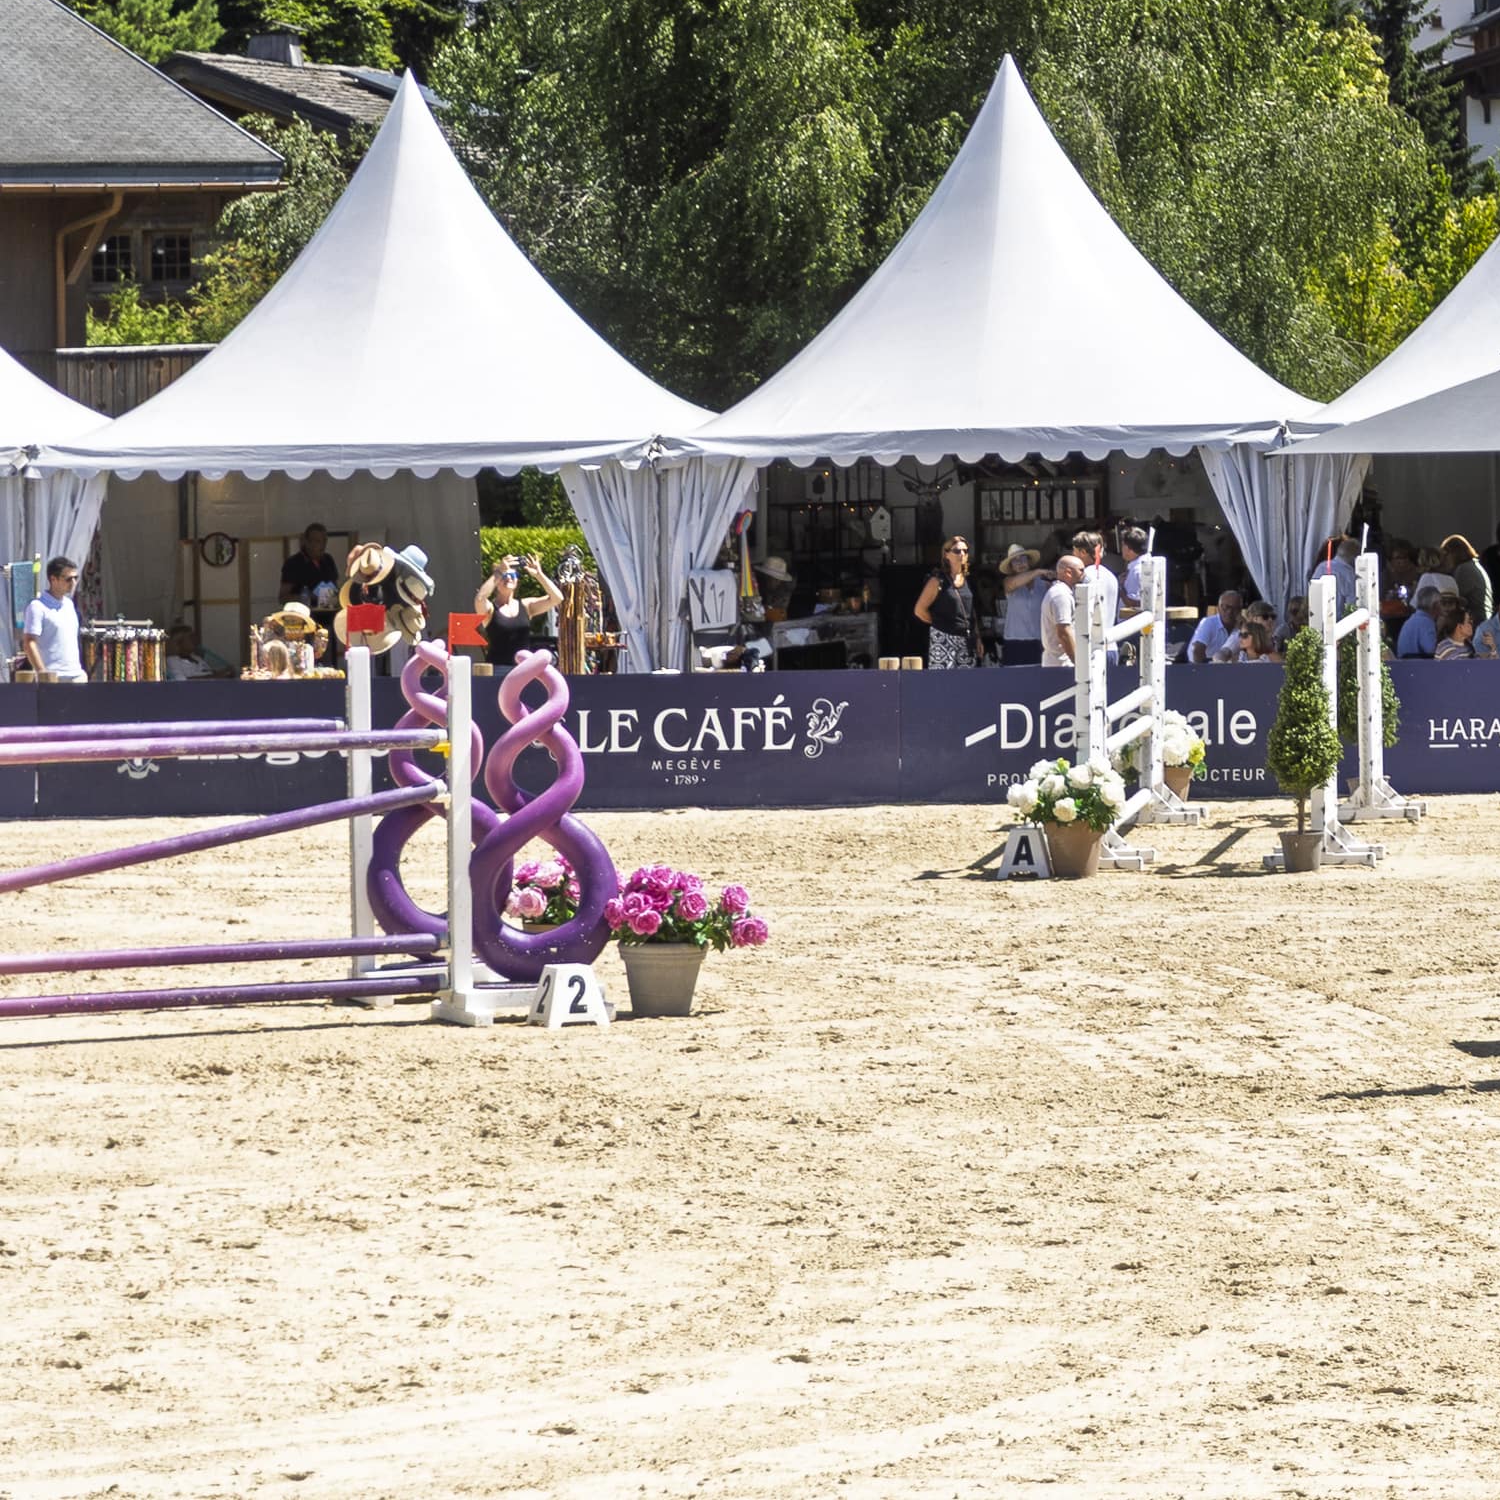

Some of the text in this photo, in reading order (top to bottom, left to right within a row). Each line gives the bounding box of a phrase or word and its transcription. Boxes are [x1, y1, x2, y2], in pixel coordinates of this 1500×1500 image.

[576, 694, 797, 753] LE CAFÉ
[651, 757, 722, 771] MEGÈVE
[674, 775, 699, 786] 1789
[1012, 835, 1035, 866] A
[536, 974, 552, 1014] 2
[567, 974, 588, 1014] 2
